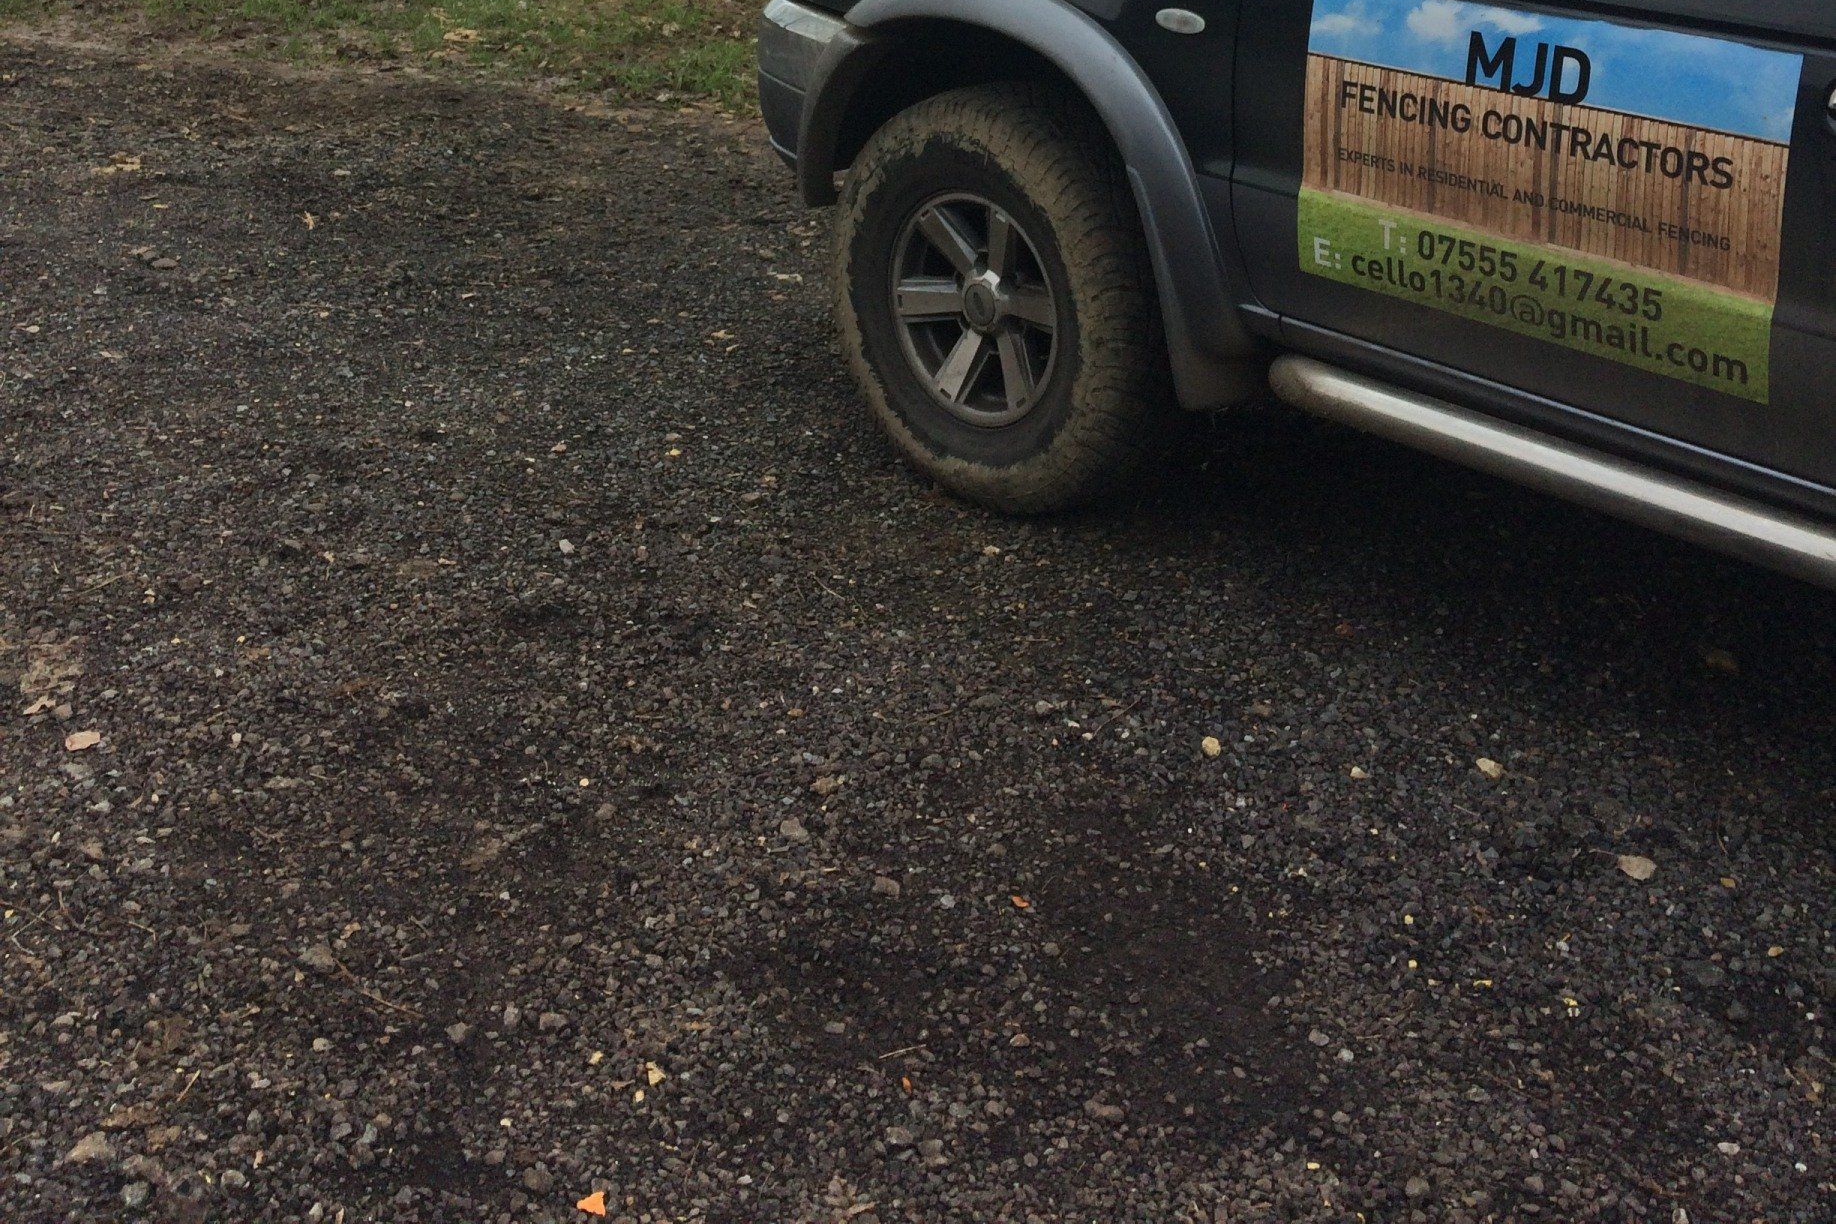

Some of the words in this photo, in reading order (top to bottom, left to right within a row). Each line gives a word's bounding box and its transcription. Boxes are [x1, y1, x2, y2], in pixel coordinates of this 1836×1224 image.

[1465, 30, 1591, 106] MJD
[1340, 80, 1471, 133] FENCING
[1481, 109, 1734, 189] CONTRACTORS
[1338, 148, 1396, 172] EXPERTS
[1399, 160, 1415, 176] IN
[1416, 164, 1508, 199] RESIDENTIAL
[1513, 187, 1545, 209] AND
[1549, 197, 1652, 234] COMMERCIAL
[1658, 222, 1731, 250] FENCING
[1313, 236, 1341, 270] E:
[1351, 253, 1748, 384] cello1340@gmail.com
[1378, 219, 1407, 254] T:
[1416, 229, 1518, 283] 07555
[1528, 260, 1664, 323] 417435
